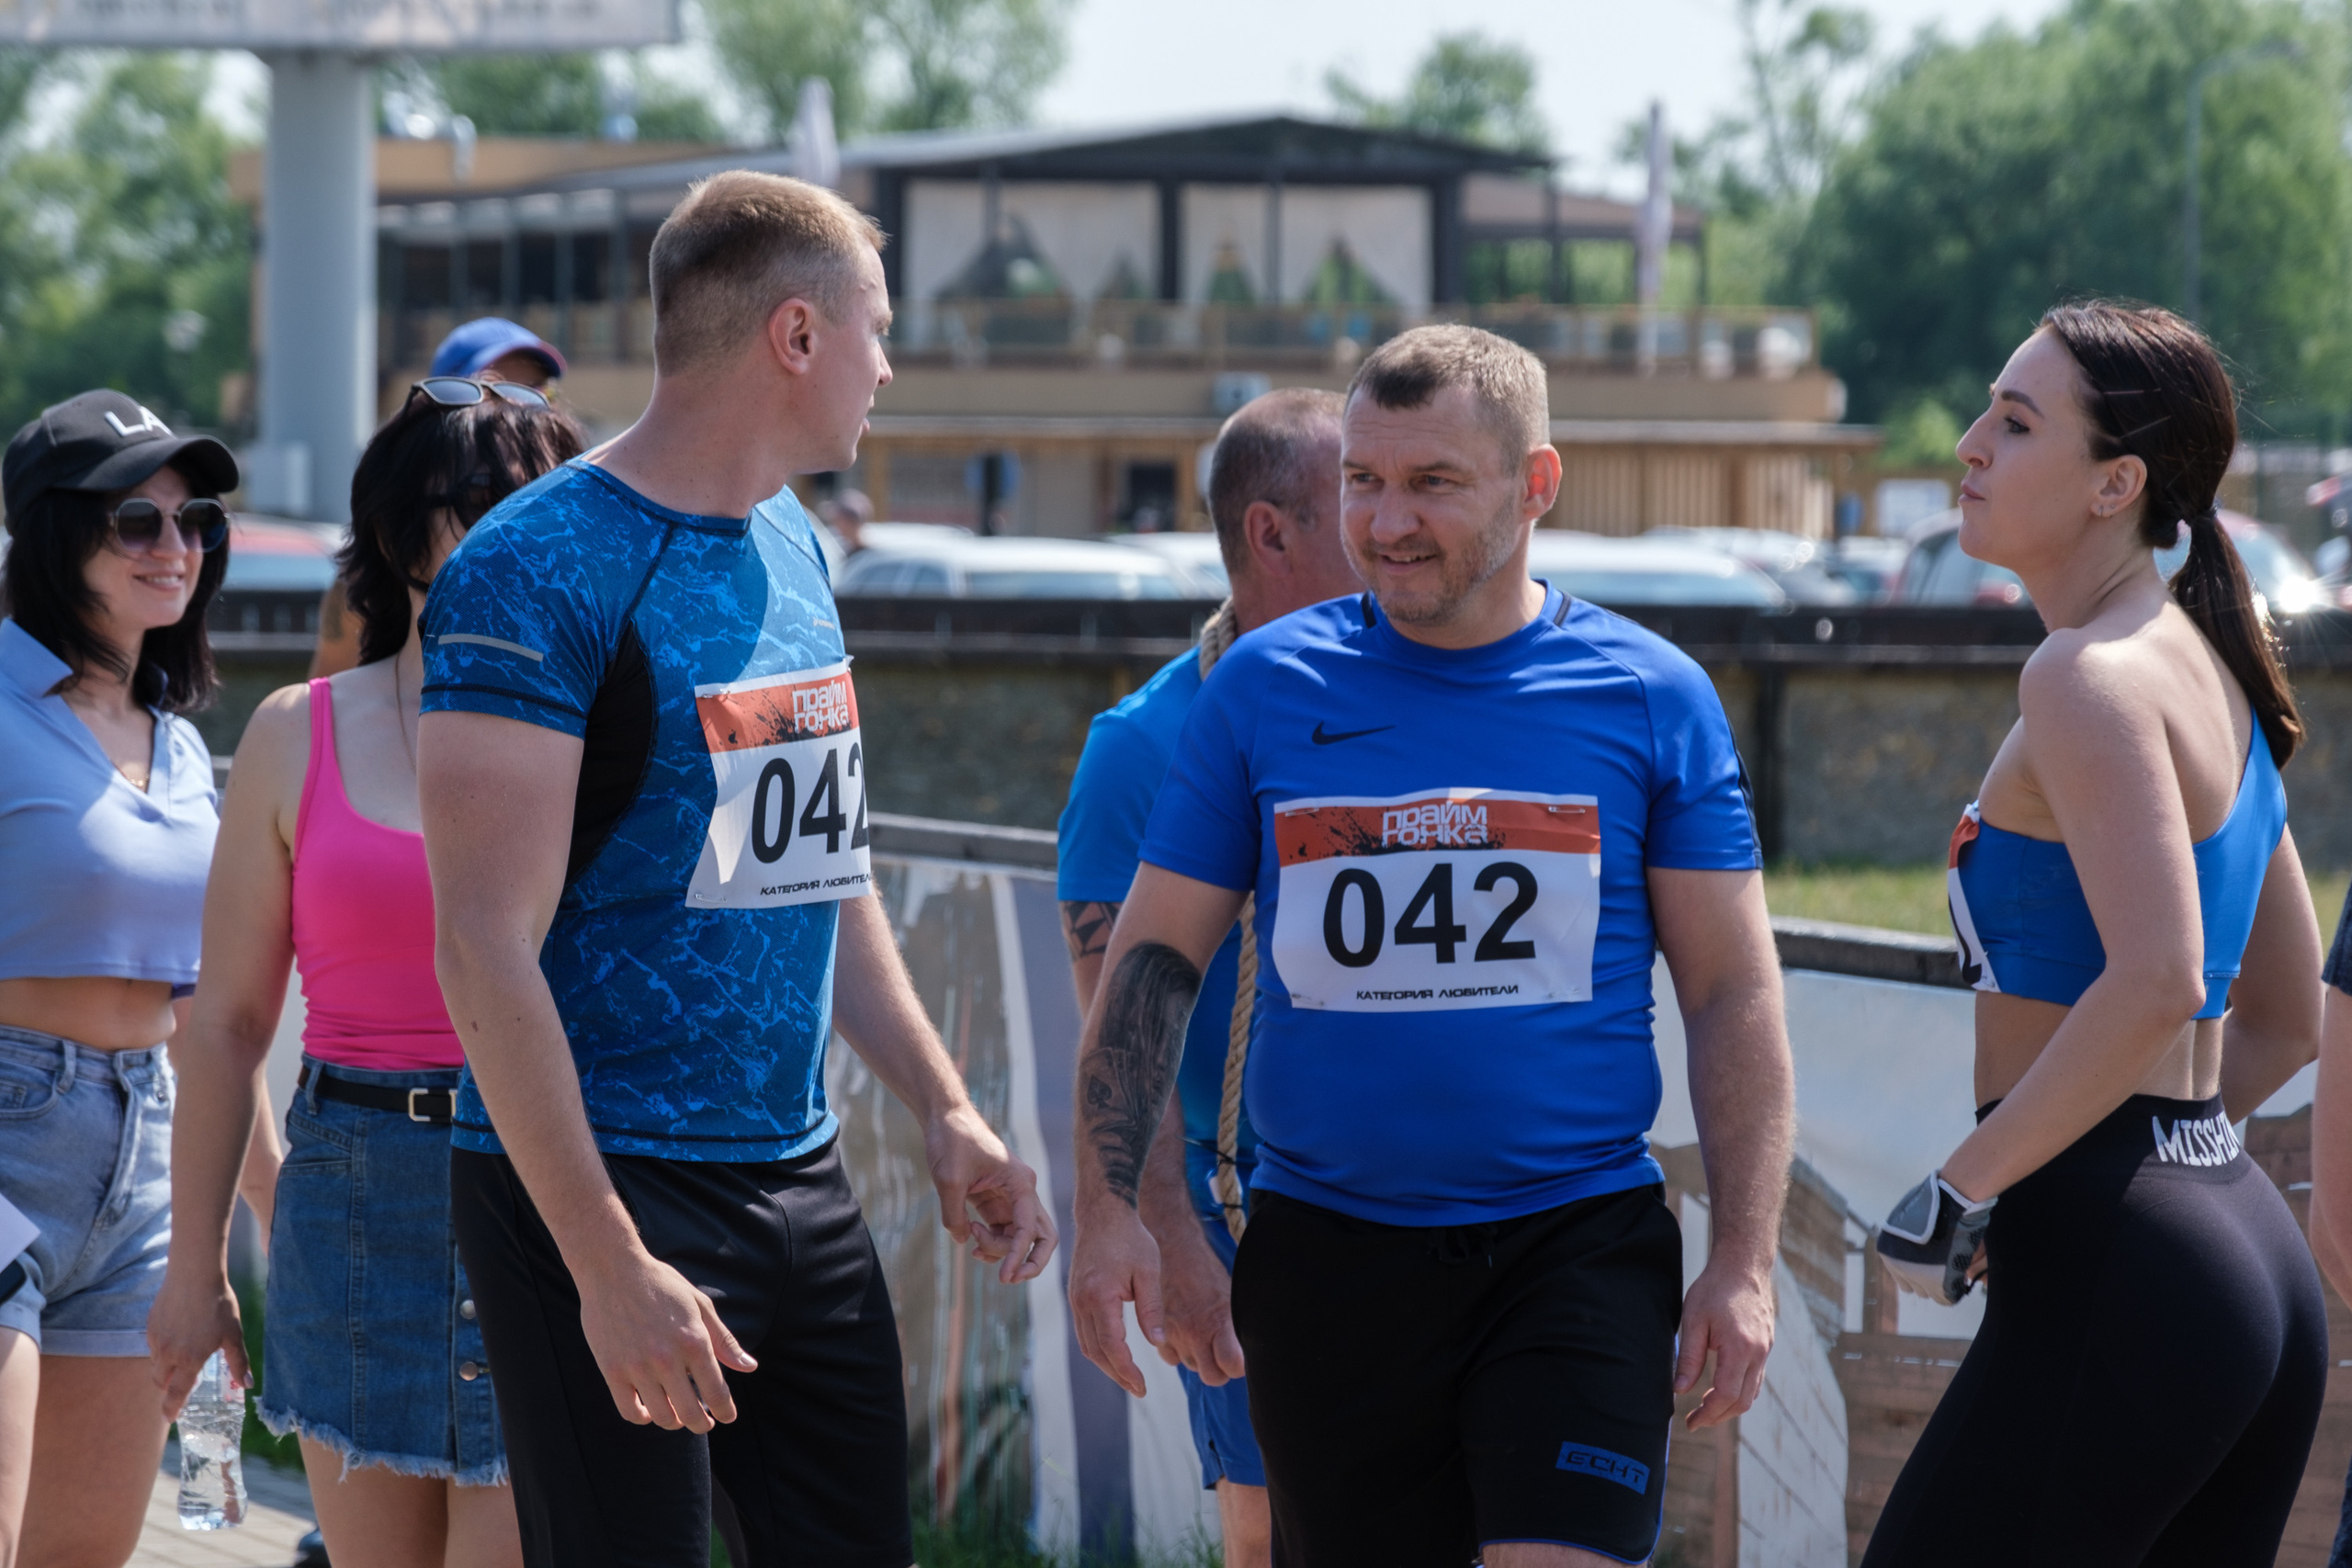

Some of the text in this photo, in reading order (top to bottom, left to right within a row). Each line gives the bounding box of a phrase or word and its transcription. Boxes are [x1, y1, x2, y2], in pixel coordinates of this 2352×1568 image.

[105, 405, 177, 437] LA
[752, 742, 870, 864] 042
[760, 880, 820, 896] КАТЕГОРИЯ
[1323, 862, 1538, 967] 042
[1356, 985, 1519, 1001] КАТЕГОРИЯ ЛЮБИТЕЛИ
[1566, 1450, 1645, 1484] ECHT
